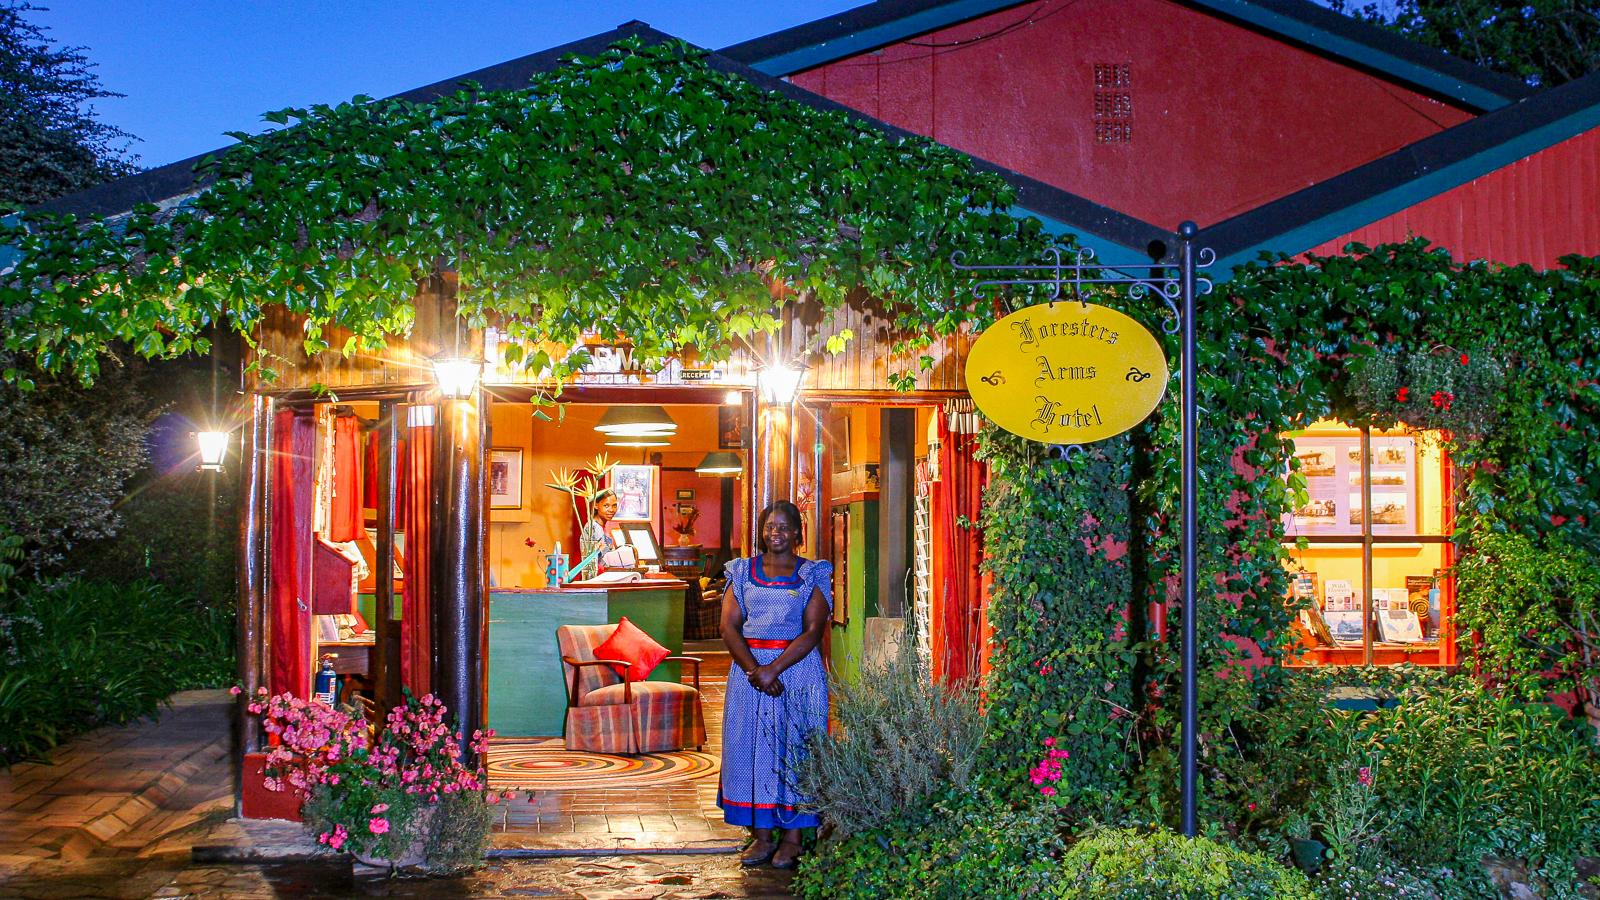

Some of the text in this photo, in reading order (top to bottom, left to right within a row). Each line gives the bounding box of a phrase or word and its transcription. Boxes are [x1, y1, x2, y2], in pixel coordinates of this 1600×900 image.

[1010, 317, 1120, 353] Foresters
[1034, 355, 1096, 388] Arms
[1030, 395, 1103, 433] Hotel
